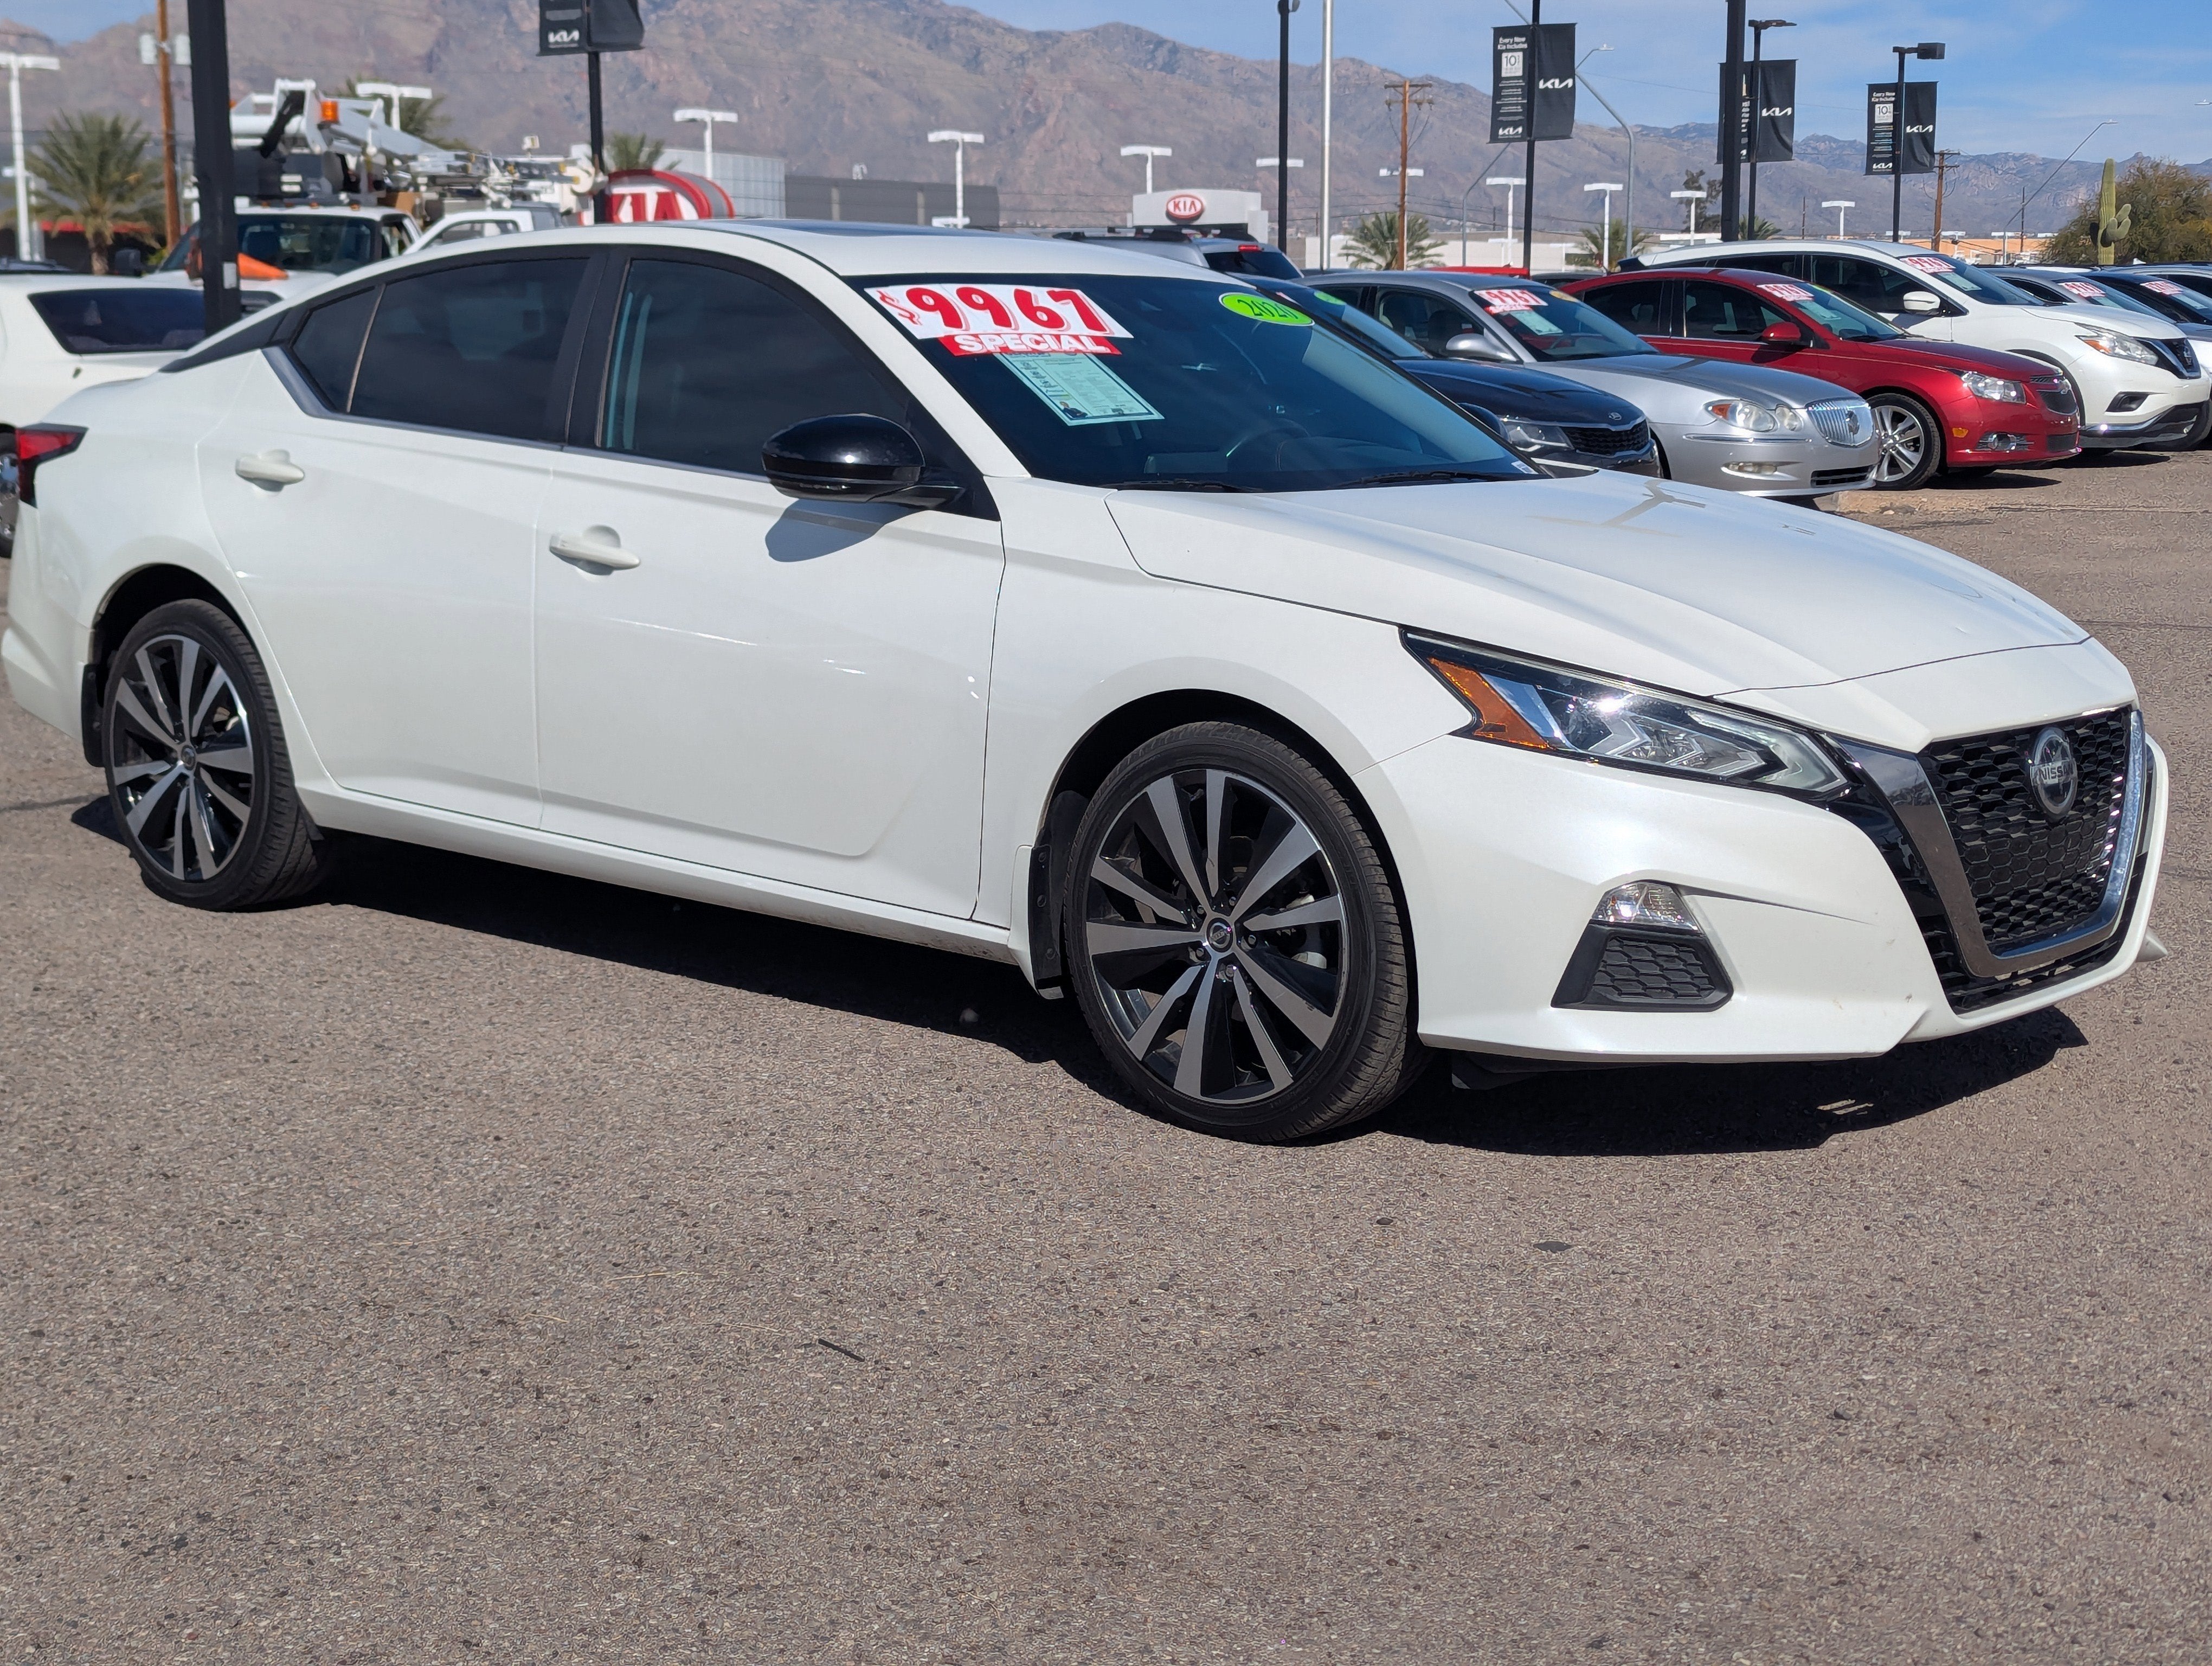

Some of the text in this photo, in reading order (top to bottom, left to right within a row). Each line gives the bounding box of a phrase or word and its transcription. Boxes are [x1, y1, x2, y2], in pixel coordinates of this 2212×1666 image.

[548, 29, 580, 43] KIA
[1539, 78, 1573, 89] KIA
[1762, 107, 1792, 116] KIA
[1498, 126, 1522, 135] KIA
[1173, 200, 1197, 212] KIA
[877, 287, 1113, 334] $9967
[954, 333, 1113, 354] SPECIAL
